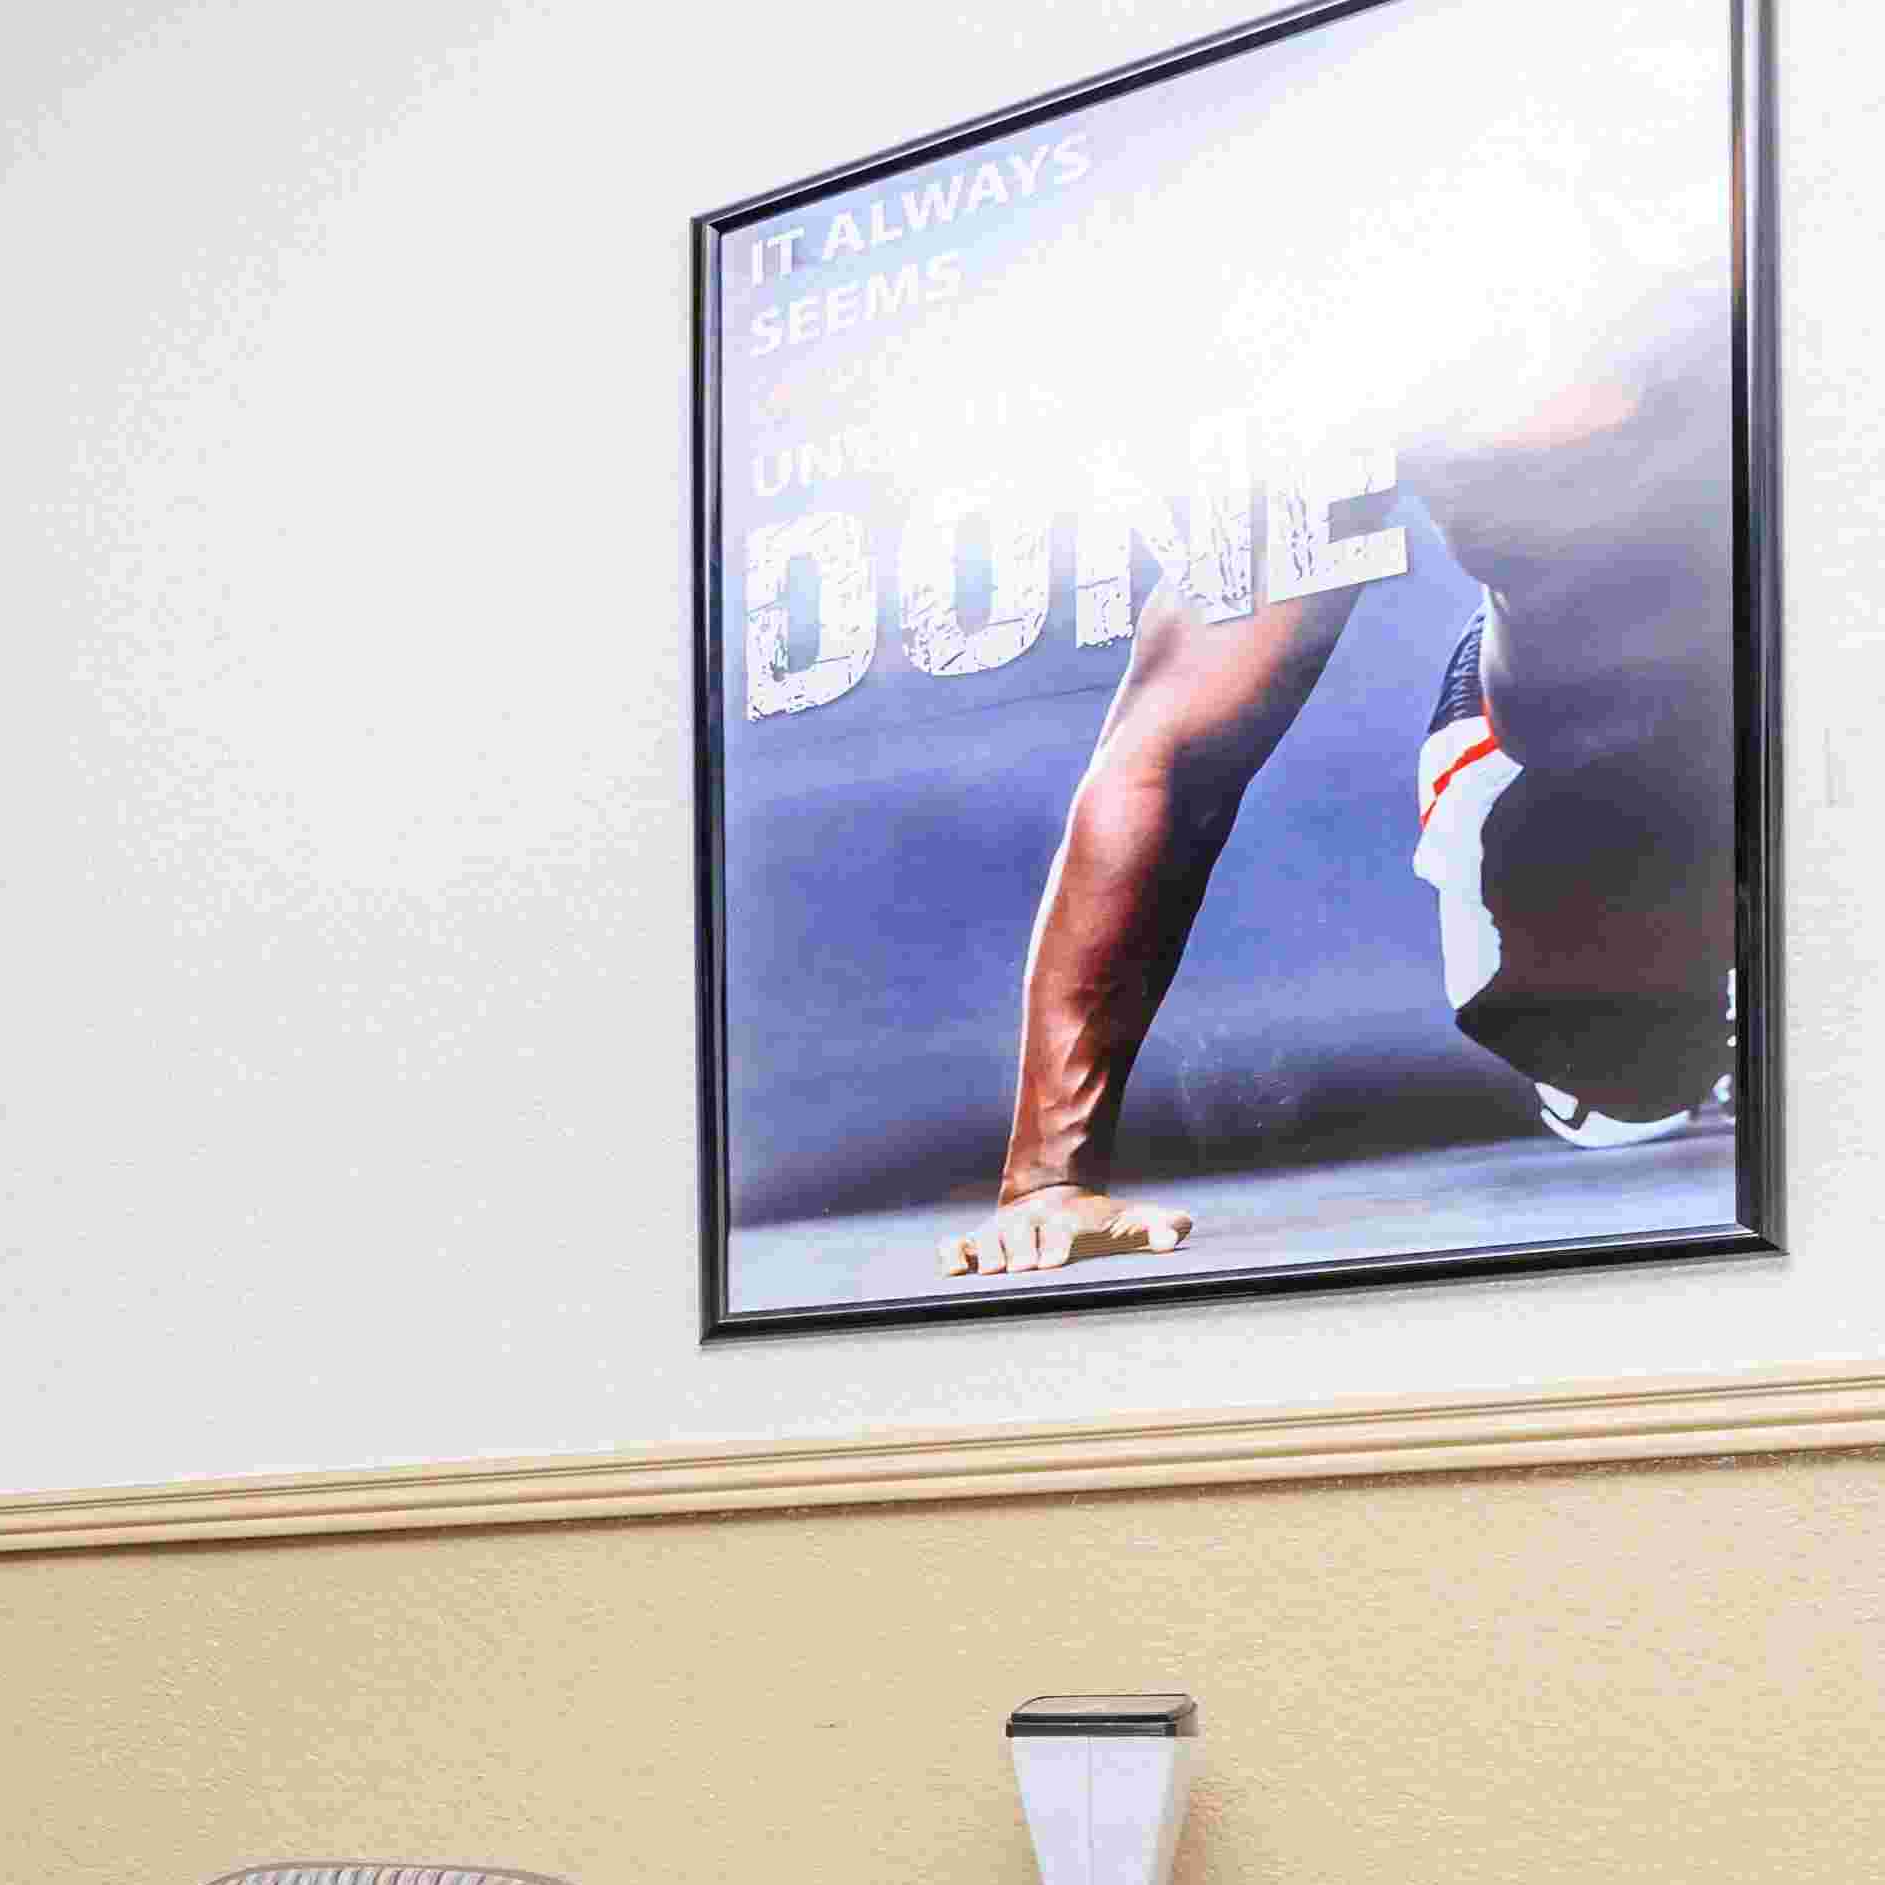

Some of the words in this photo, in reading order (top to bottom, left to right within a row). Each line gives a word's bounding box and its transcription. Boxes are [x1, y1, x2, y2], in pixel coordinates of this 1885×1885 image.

[750, 226, 806, 287] IT
[821, 133, 1093, 260] ALWAYS
[749, 250, 964, 358] SEEMS
[745, 416, 1410, 723] DONE
